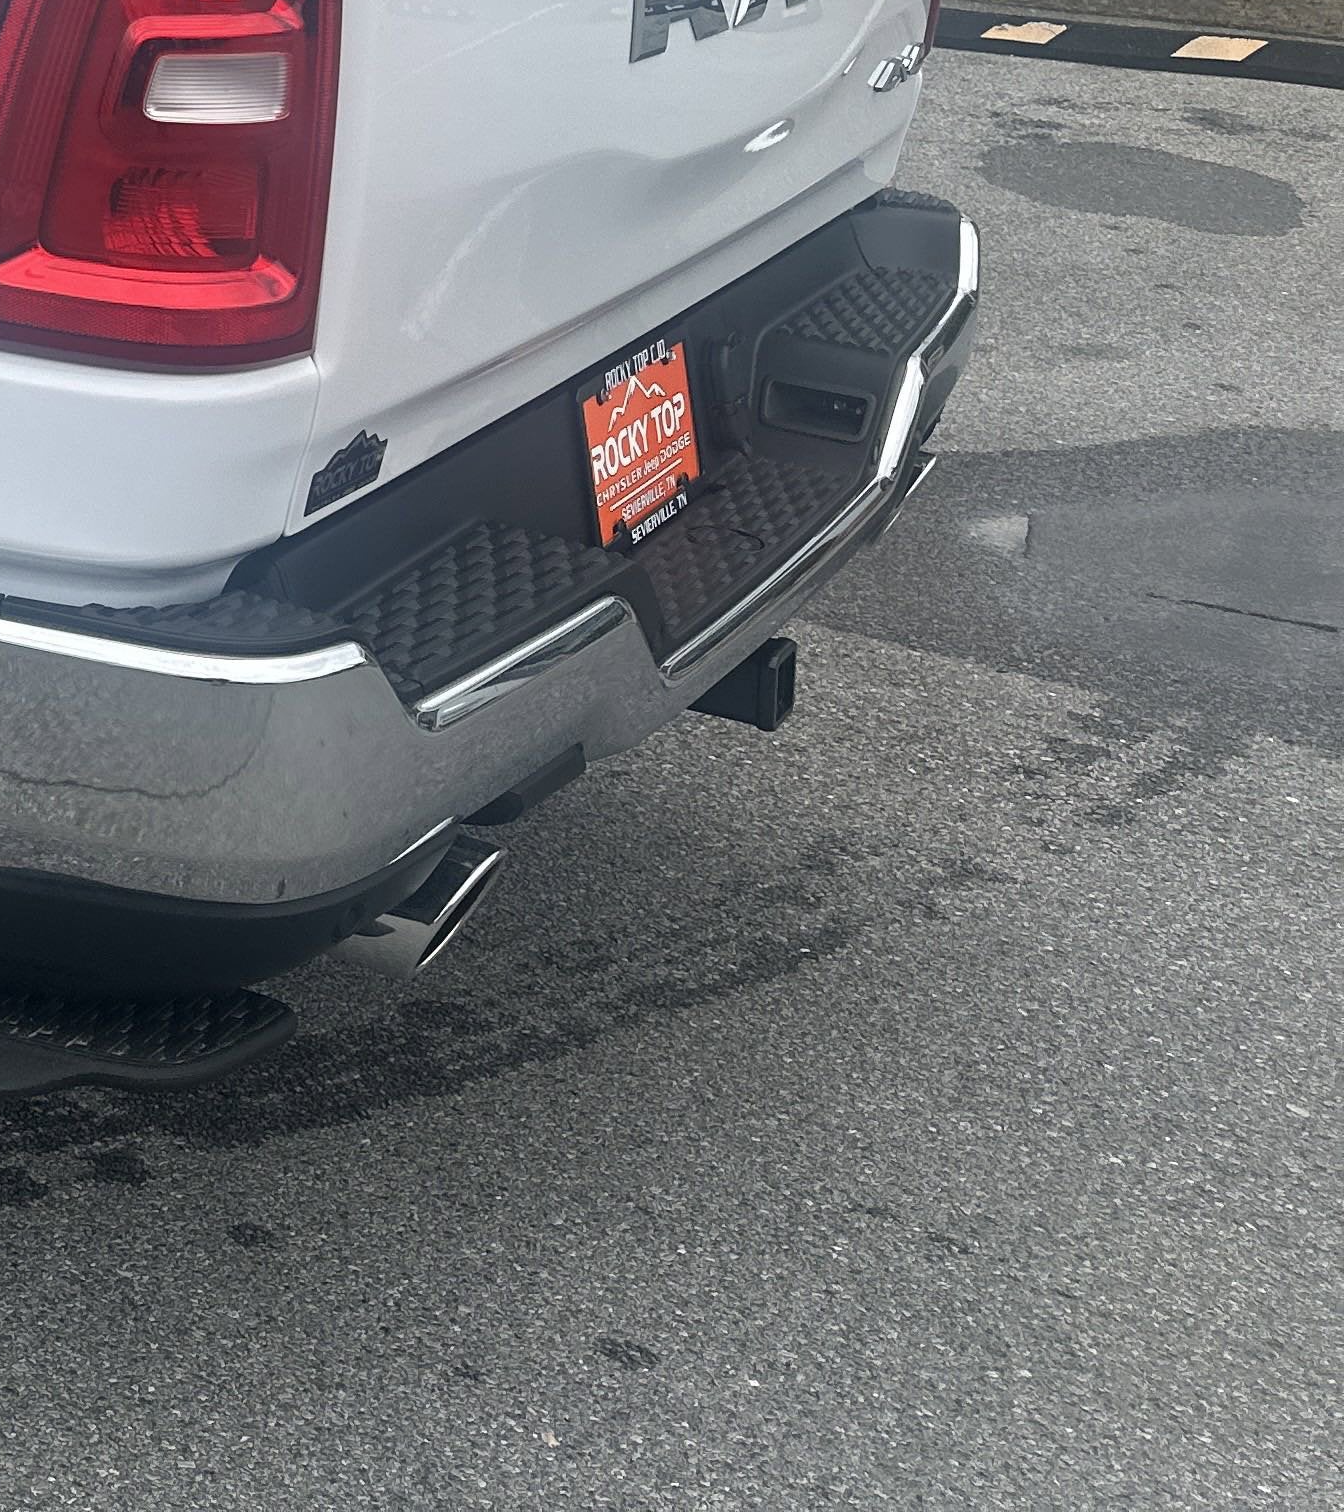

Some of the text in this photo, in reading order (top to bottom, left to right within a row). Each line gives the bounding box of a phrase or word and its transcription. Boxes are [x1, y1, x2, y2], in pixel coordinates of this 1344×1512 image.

[605, 358, 633, 391] ROCKY
[632, 348, 650, 374] TOP
[591, 392, 686, 486] ROCKY TOP
[596, 432, 691, 507] CHRYSLER Jeep DODGE
[676, 493, 688, 511] TN
